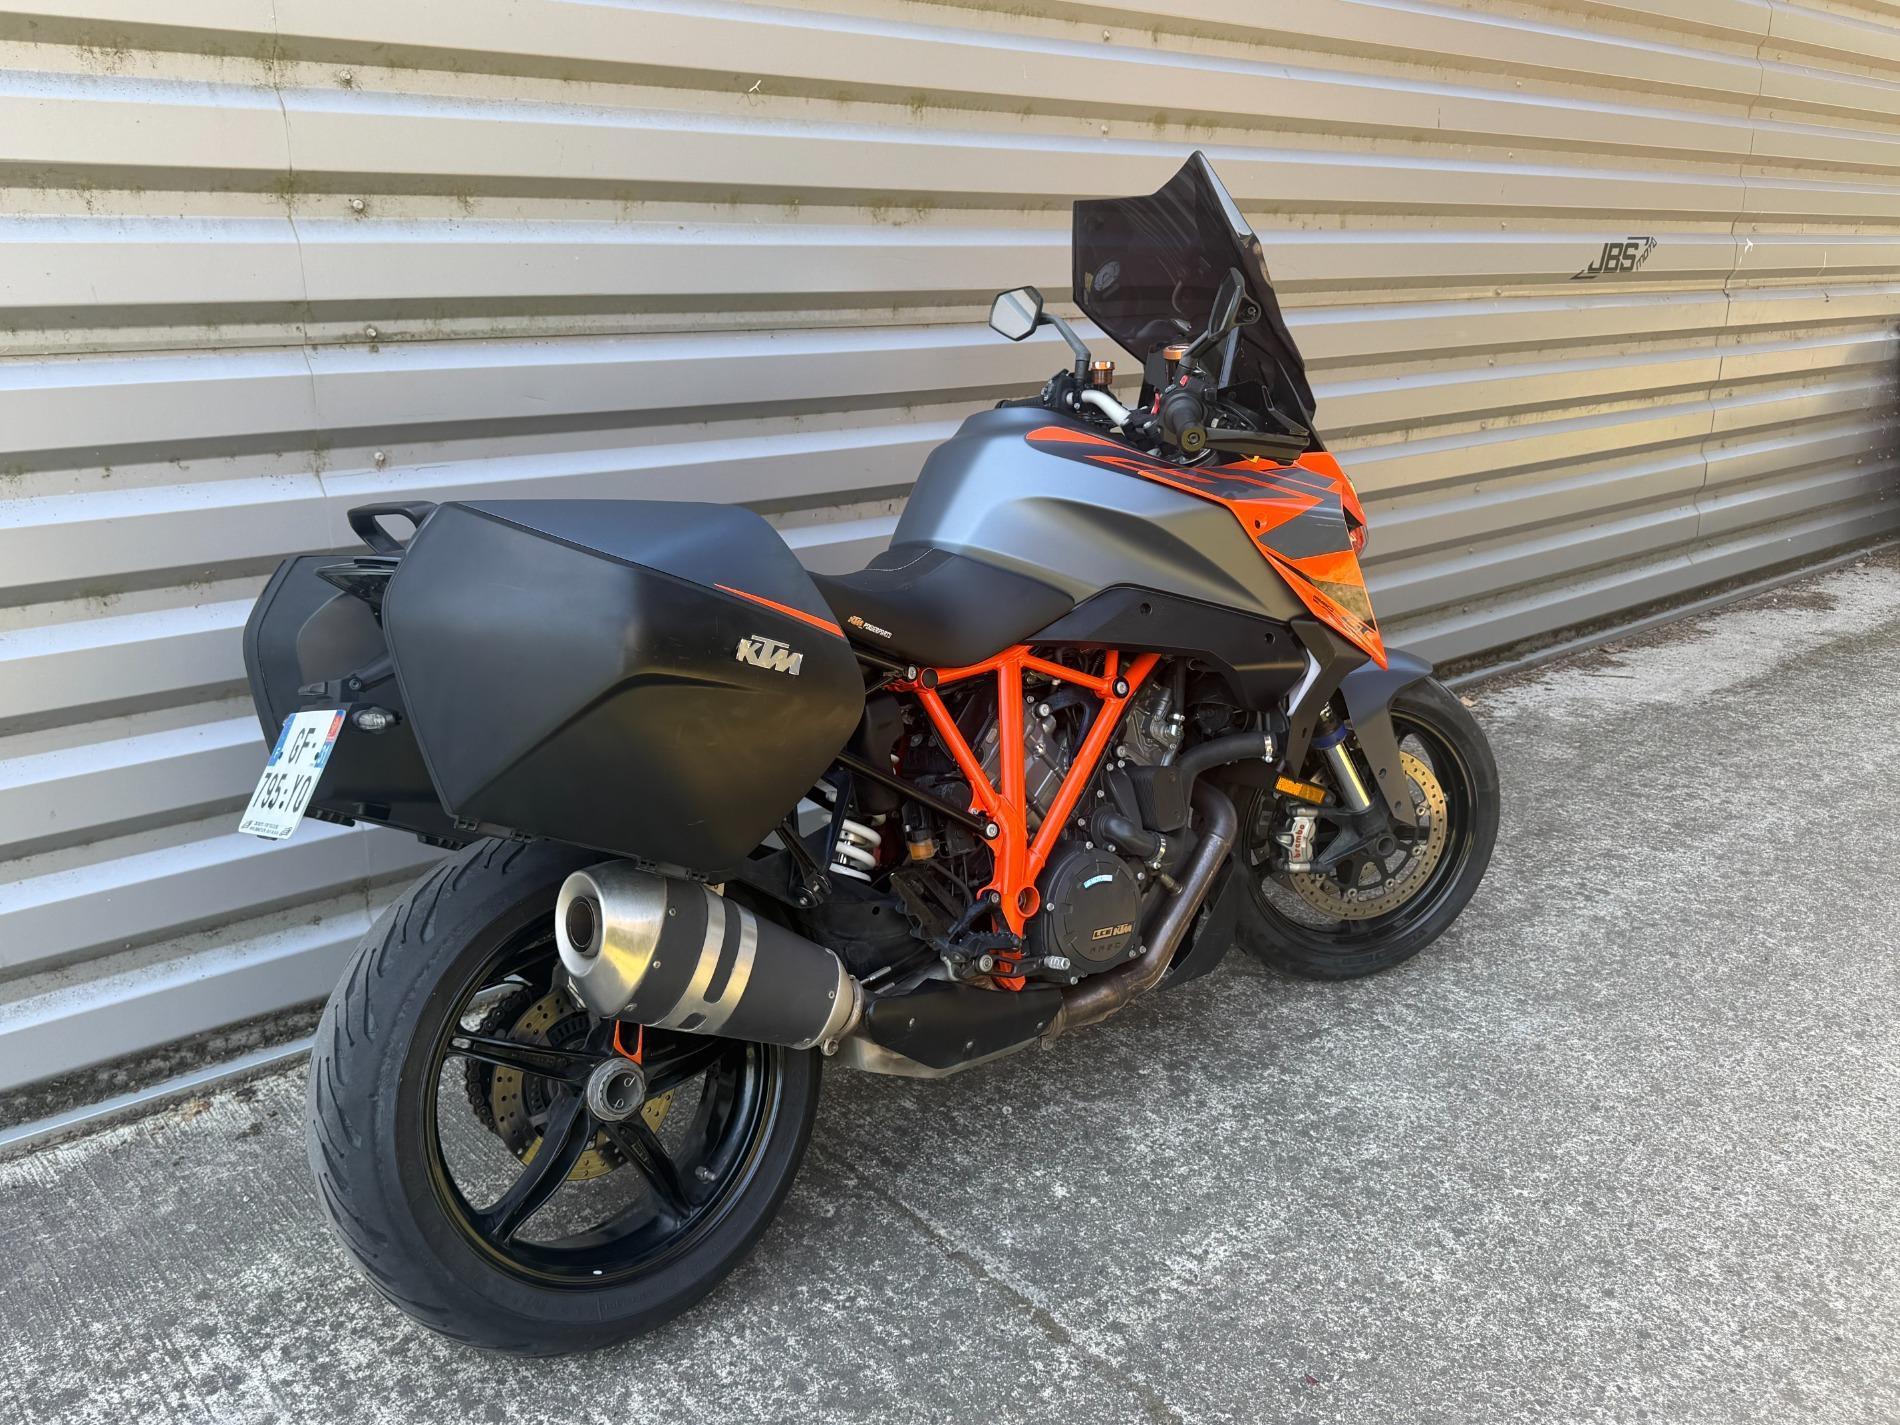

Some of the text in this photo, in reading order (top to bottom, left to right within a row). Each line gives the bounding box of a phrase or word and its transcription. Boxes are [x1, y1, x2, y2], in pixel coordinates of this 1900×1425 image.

[1588, 242, 1639, 273] JBS
[735, 634, 804, 676] KTM
[1293, 824, 1305, 859] brembo
[1112, 923, 1132, 936] KTM
